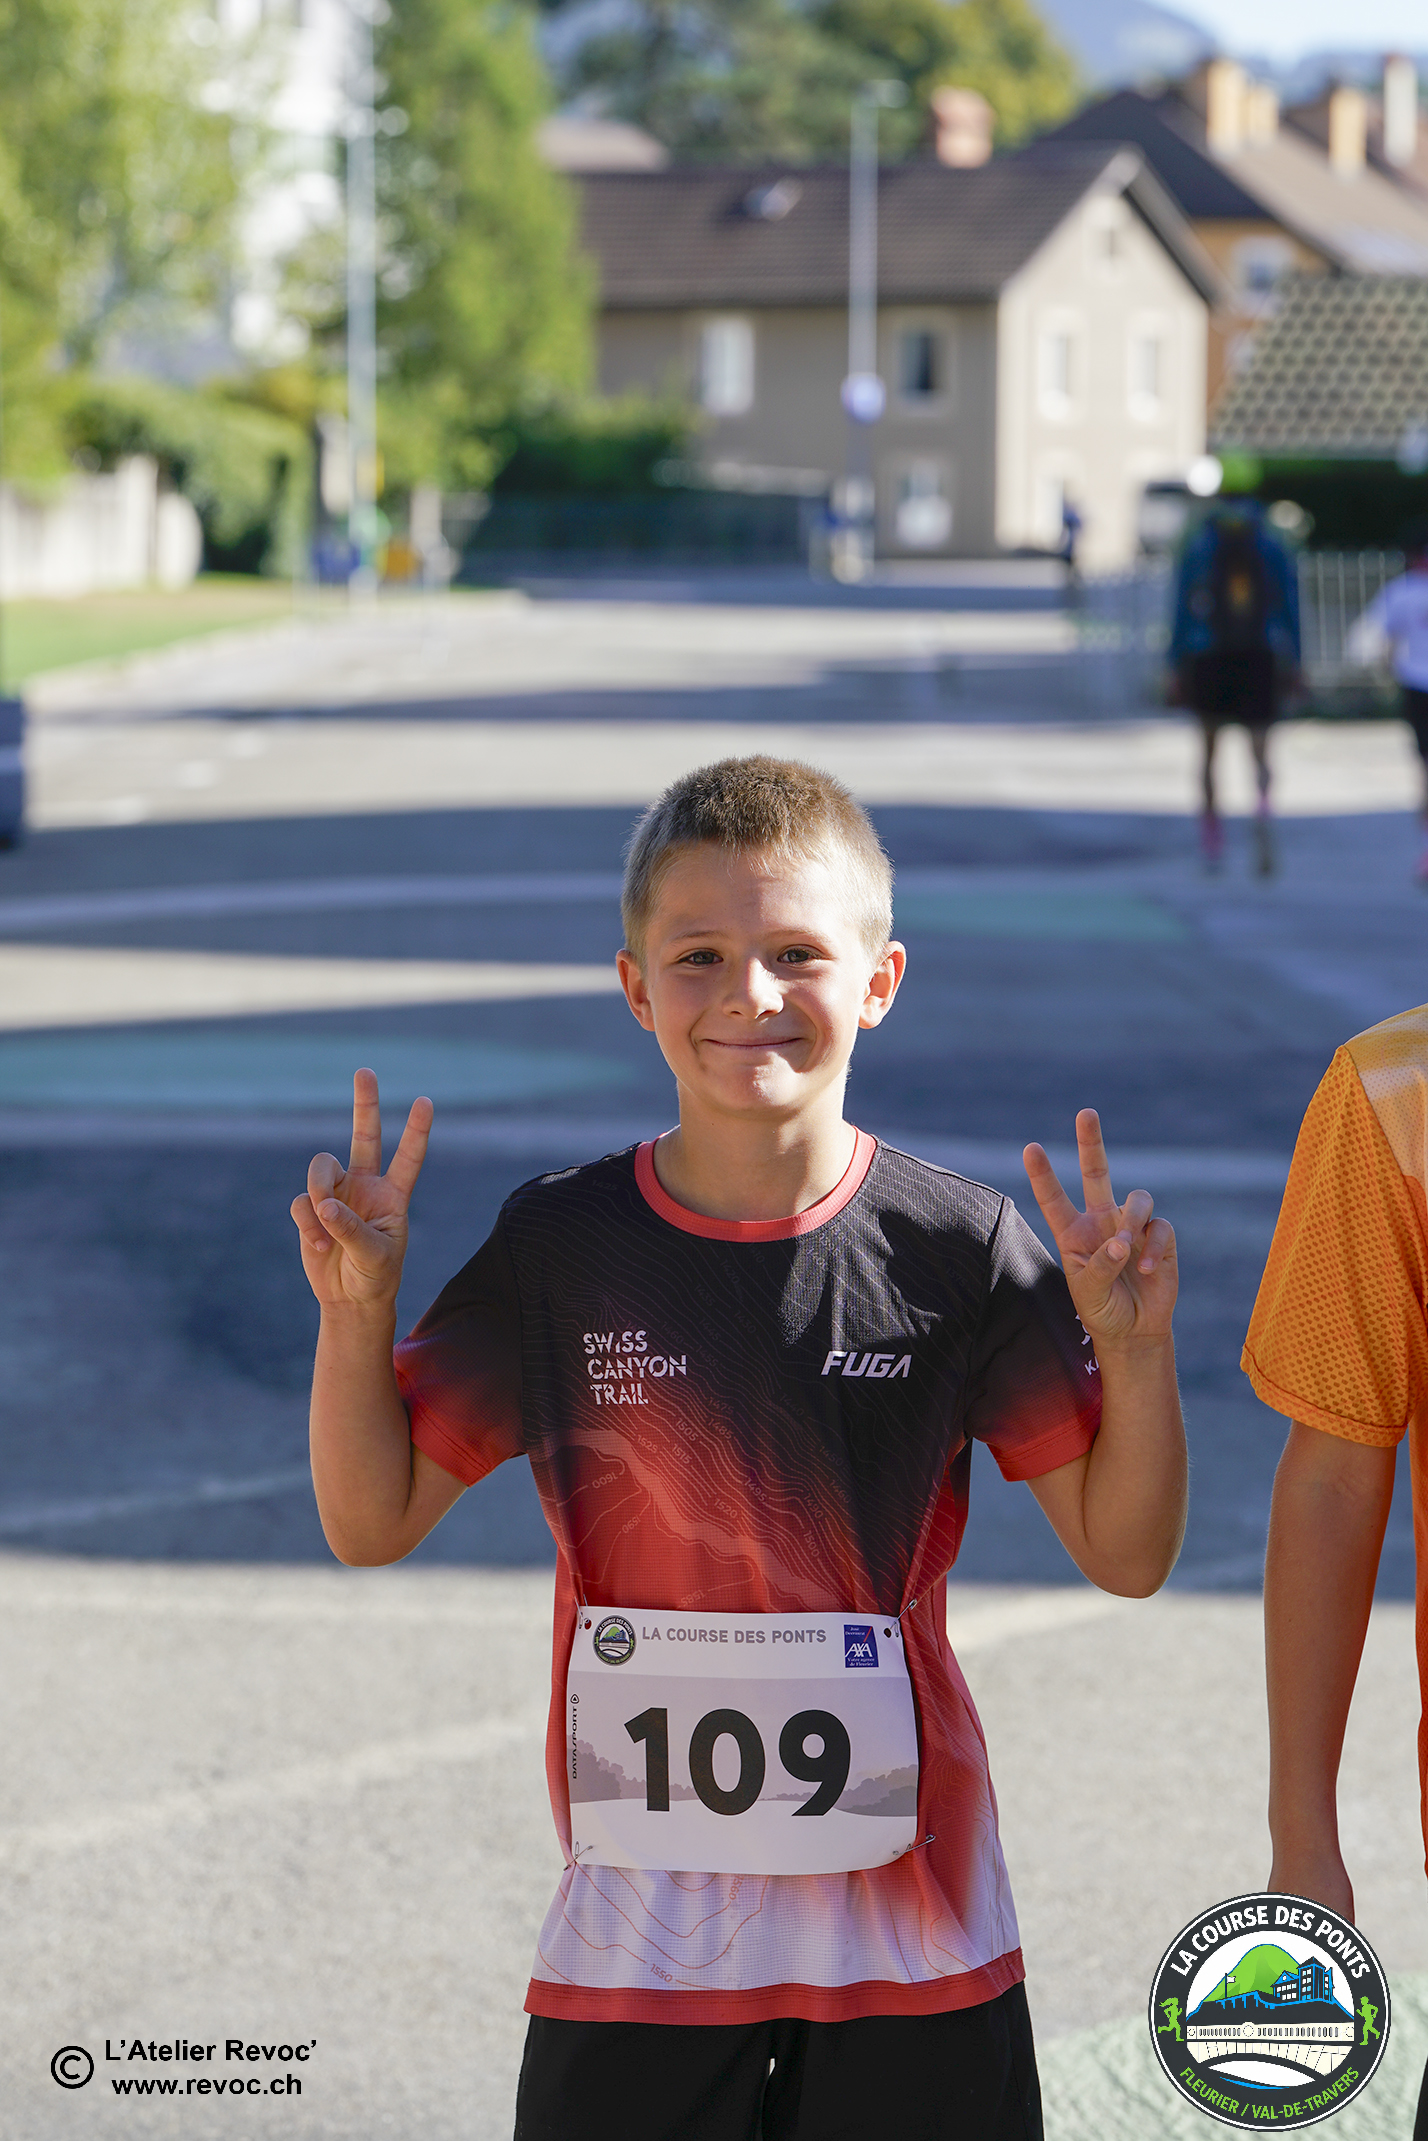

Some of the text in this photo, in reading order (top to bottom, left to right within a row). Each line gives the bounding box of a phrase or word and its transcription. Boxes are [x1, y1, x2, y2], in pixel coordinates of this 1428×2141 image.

[694, 1283, 716, 1308] 1435
[661, 1321, 684, 1344] 1460
[698, 1317, 722, 1341] 1445
[733, 1311, 757, 1335] 1430
[583, 1330, 648, 1354] SWISS
[587, 1354, 687, 1380] CANYON
[821, 1350, 912, 1379] FUGA
[590, 1382, 649, 1405] TRAIL
[708, 1397, 735, 1416] 1475
[675, 1416, 699, 1442] 1505
[707, 1417, 733, 1440] 1485
[637, 1434, 659, 1454] 1525
[671, 1443, 692, 1465] 1515
[819, 1445, 844, 1468] 1450
[592, 1474, 617, 1490] 1600
[744, 1477, 768, 1503] 1495
[829, 1479, 853, 1504] 1460
[714, 1498, 738, 1519] 1520
[804, 1492, 824, 1520] 1490
[621, 1517, 640, 1534] 1590
[803, 1531, 820, 1558] 1500
[681, 1590, 705, 1608] 1585
[642, 1626, 827, 1644] LA COURSE DES PONTS
[844, 1643, 873, 1657] AXA
[623, 1707, 851, 1817] 109
[650, 1963, 674, 1984] 1550
